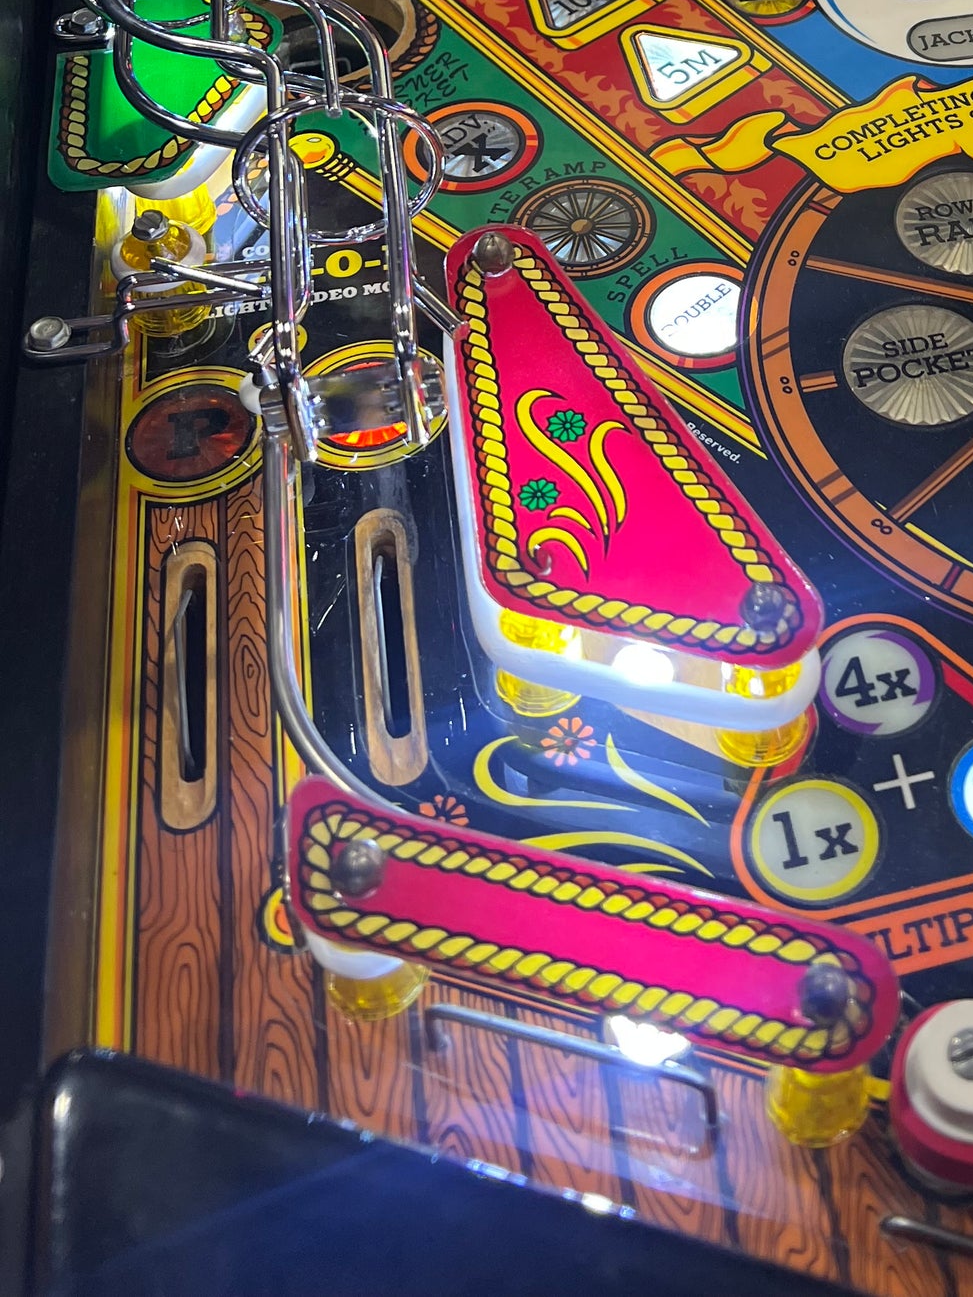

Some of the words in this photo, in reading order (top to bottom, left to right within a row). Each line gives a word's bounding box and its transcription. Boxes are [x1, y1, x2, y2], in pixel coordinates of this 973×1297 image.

[656, 50, 722, 87] 5M
[856, 113, 965, 163] LIGHTS
[522, 161, 607, 192] RAMP
[607, 246, 689, 303] SPELL
[661, 282, 732, 338] DOUBLE
[882, 333, 949, 358] SIDE
[167, 407, 231, 459] P
[834, 655, 918, 709] 4x
[772, 810, 859, 870] 1x
